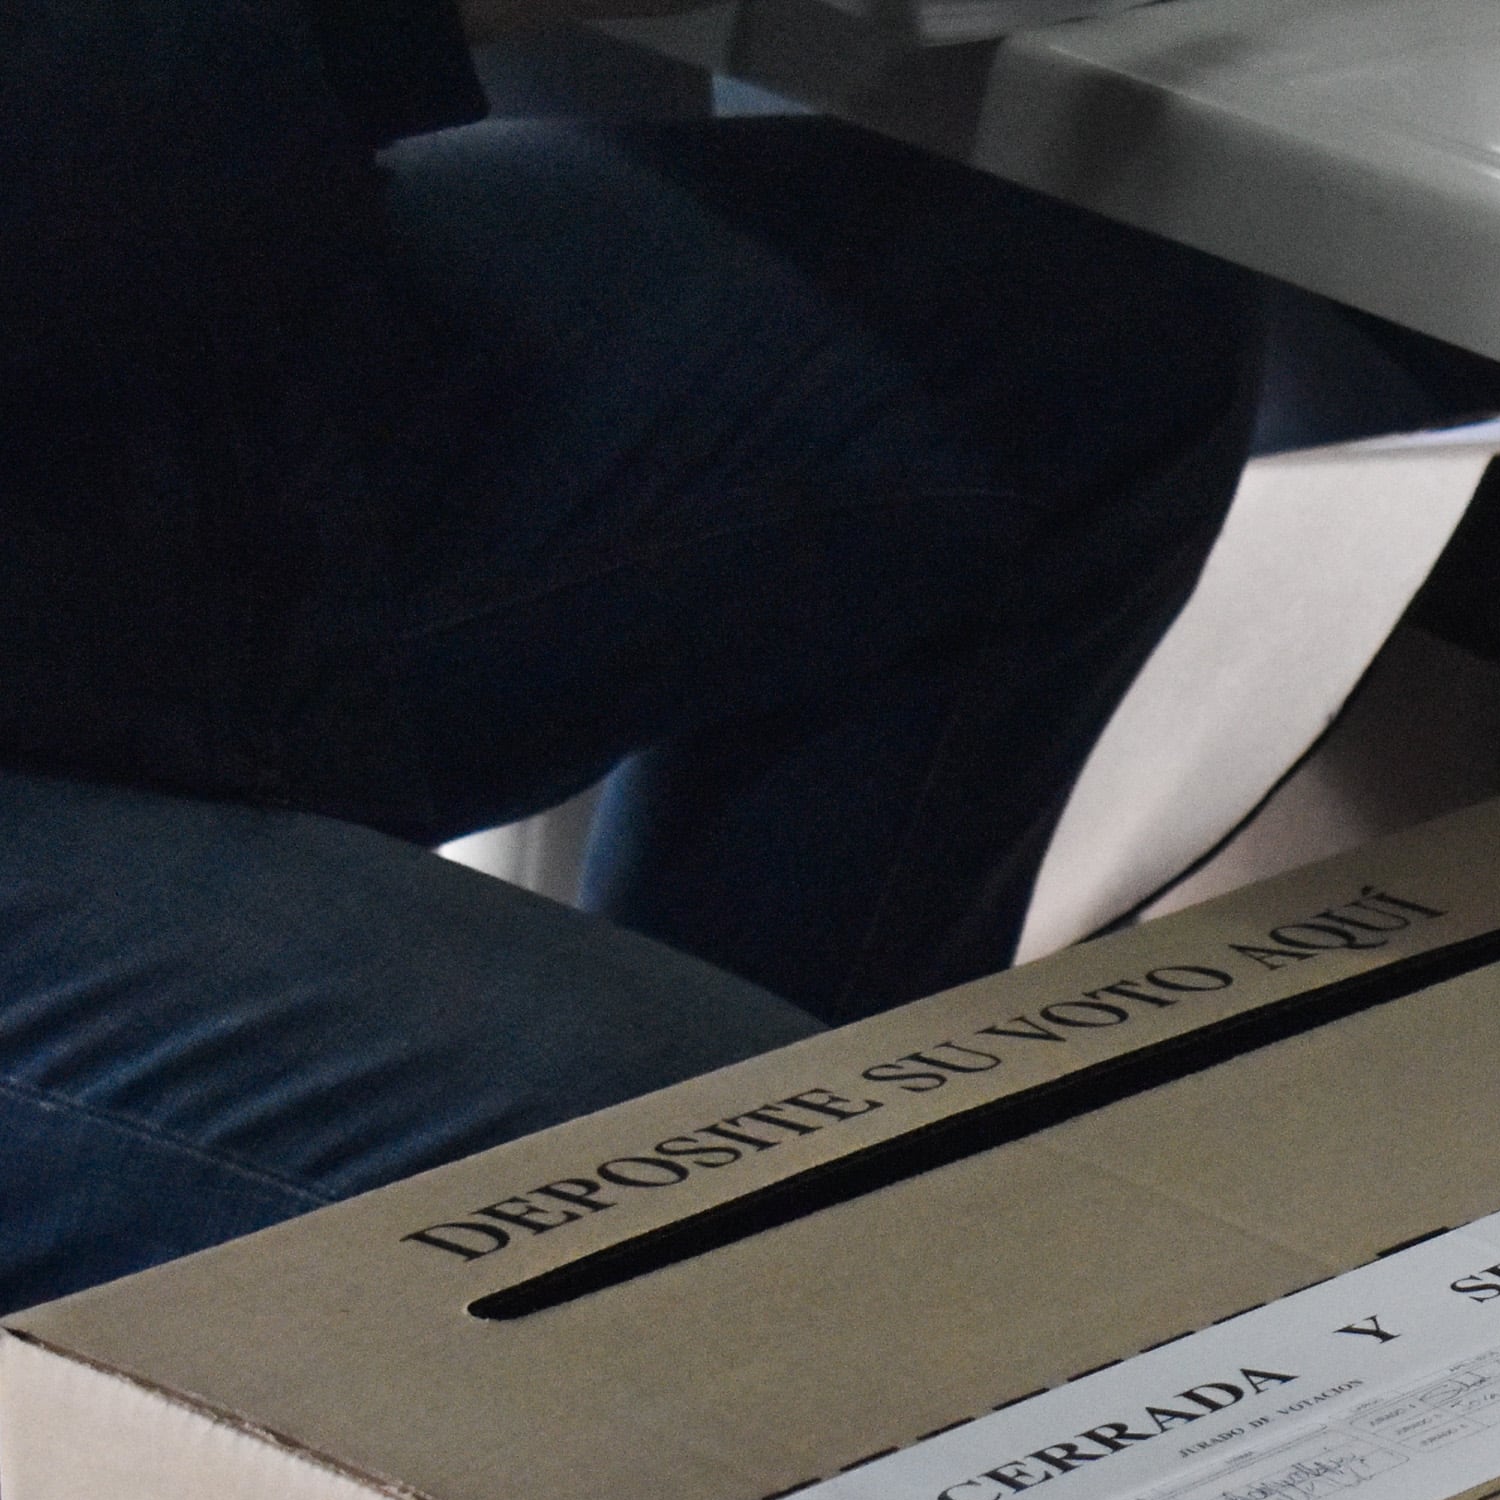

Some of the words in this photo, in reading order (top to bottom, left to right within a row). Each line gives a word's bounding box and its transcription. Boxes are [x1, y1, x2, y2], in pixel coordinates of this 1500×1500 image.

[403, 1082, 878, 1263] DEPOSITE
[861, 1043, 1004, 1096] SU
[981, 963, 1237, 1060] VOTO
[1226, 885, 1450, 975] AQUÍ
[1334, 1314, 1401, 1345] Y
[1179, 1427, 1245, 1459] JURADO
[1247, 1415, 1270, 1429] DE
